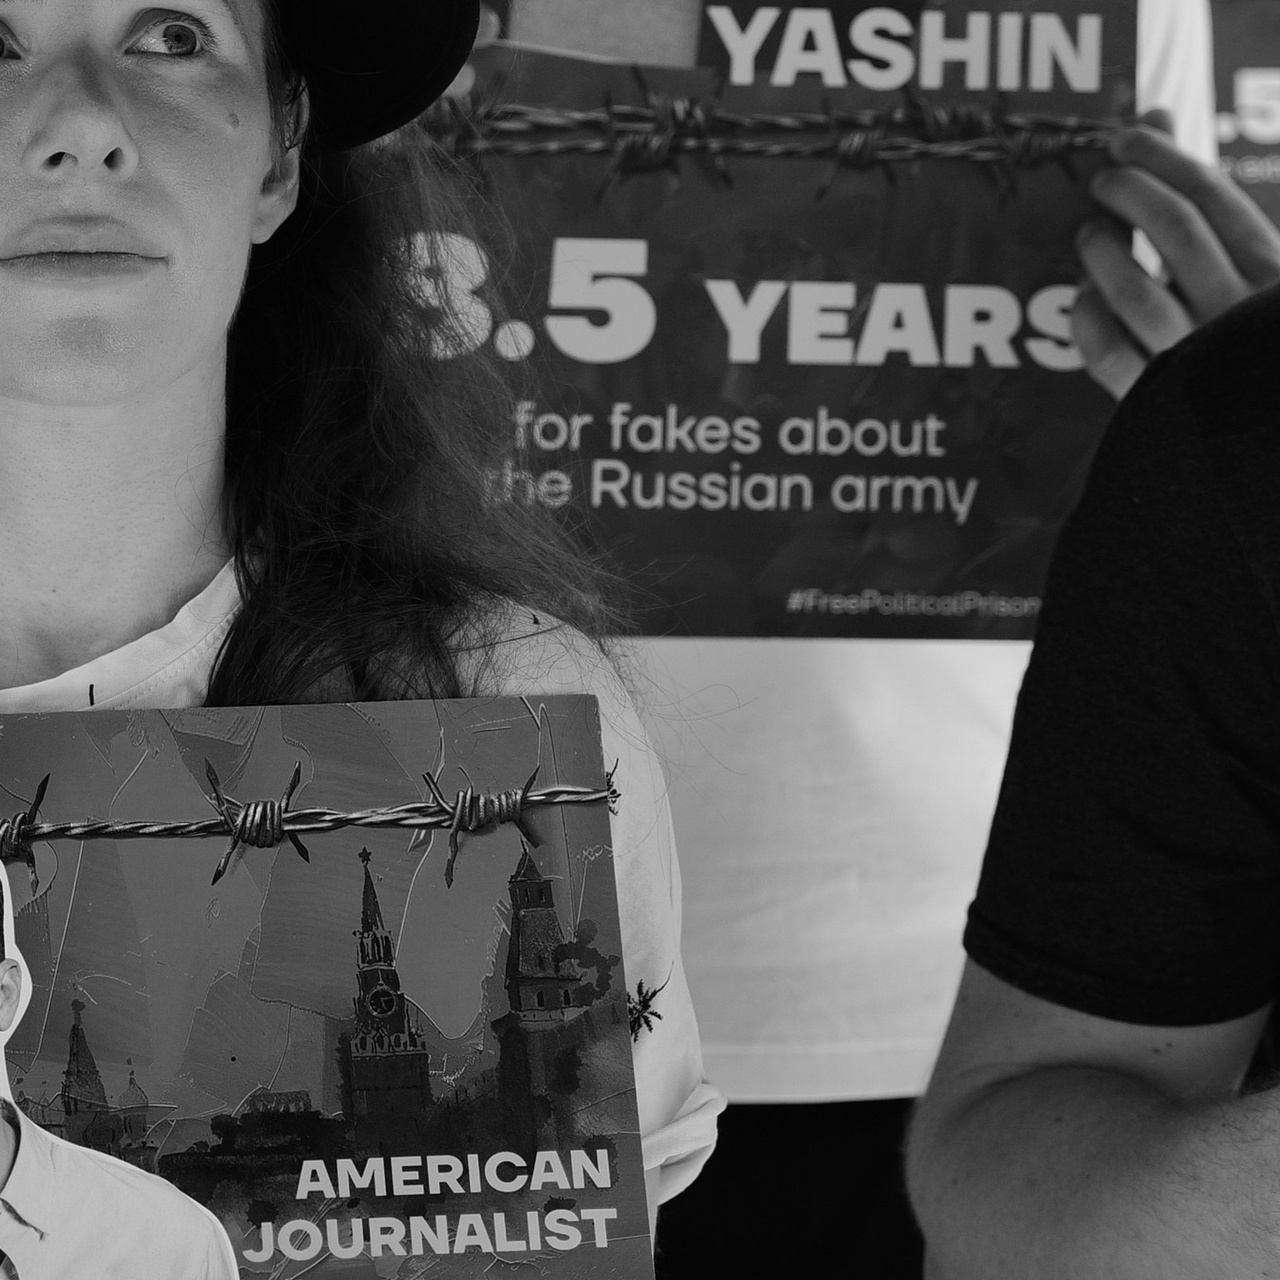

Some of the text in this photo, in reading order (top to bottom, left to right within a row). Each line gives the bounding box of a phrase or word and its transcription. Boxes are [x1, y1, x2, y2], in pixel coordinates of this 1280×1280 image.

[706, 4, 1102, 94] YASHIN
[704, 278, 1090, 372] YEARS
[517, 400, 947, 457] for fakes about
[590, 458, 813, 511] Russian
[830, 473, 979, 526] army
[296, 1148, 611, 1200] AMERICAN
[242, 1208, 617, 1262] JOURNALIST
